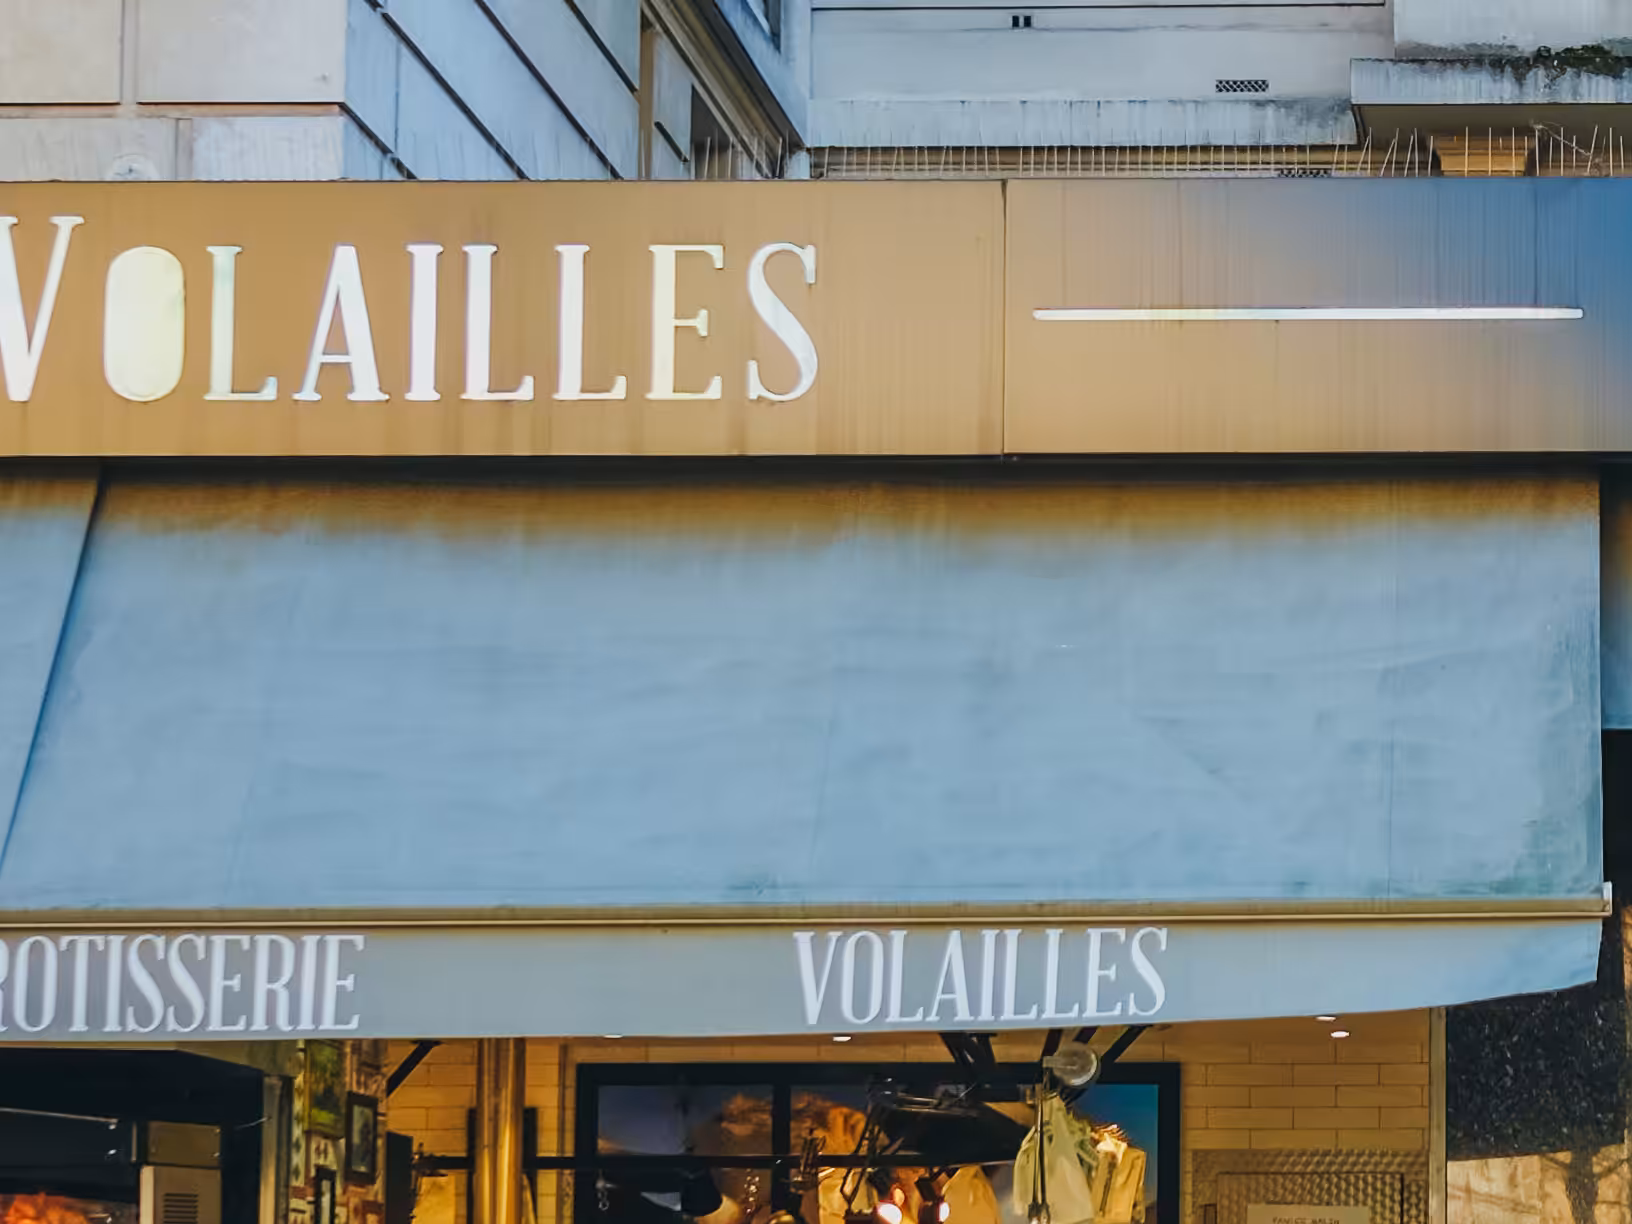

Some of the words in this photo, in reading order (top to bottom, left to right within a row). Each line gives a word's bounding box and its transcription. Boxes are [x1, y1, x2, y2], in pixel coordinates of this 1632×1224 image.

[0, 216, 819, 402] VOLAILLES
[0, 934, 366, 1033] OTISSERIE
[793, 927, 1168, 1025] VOLAILLES
